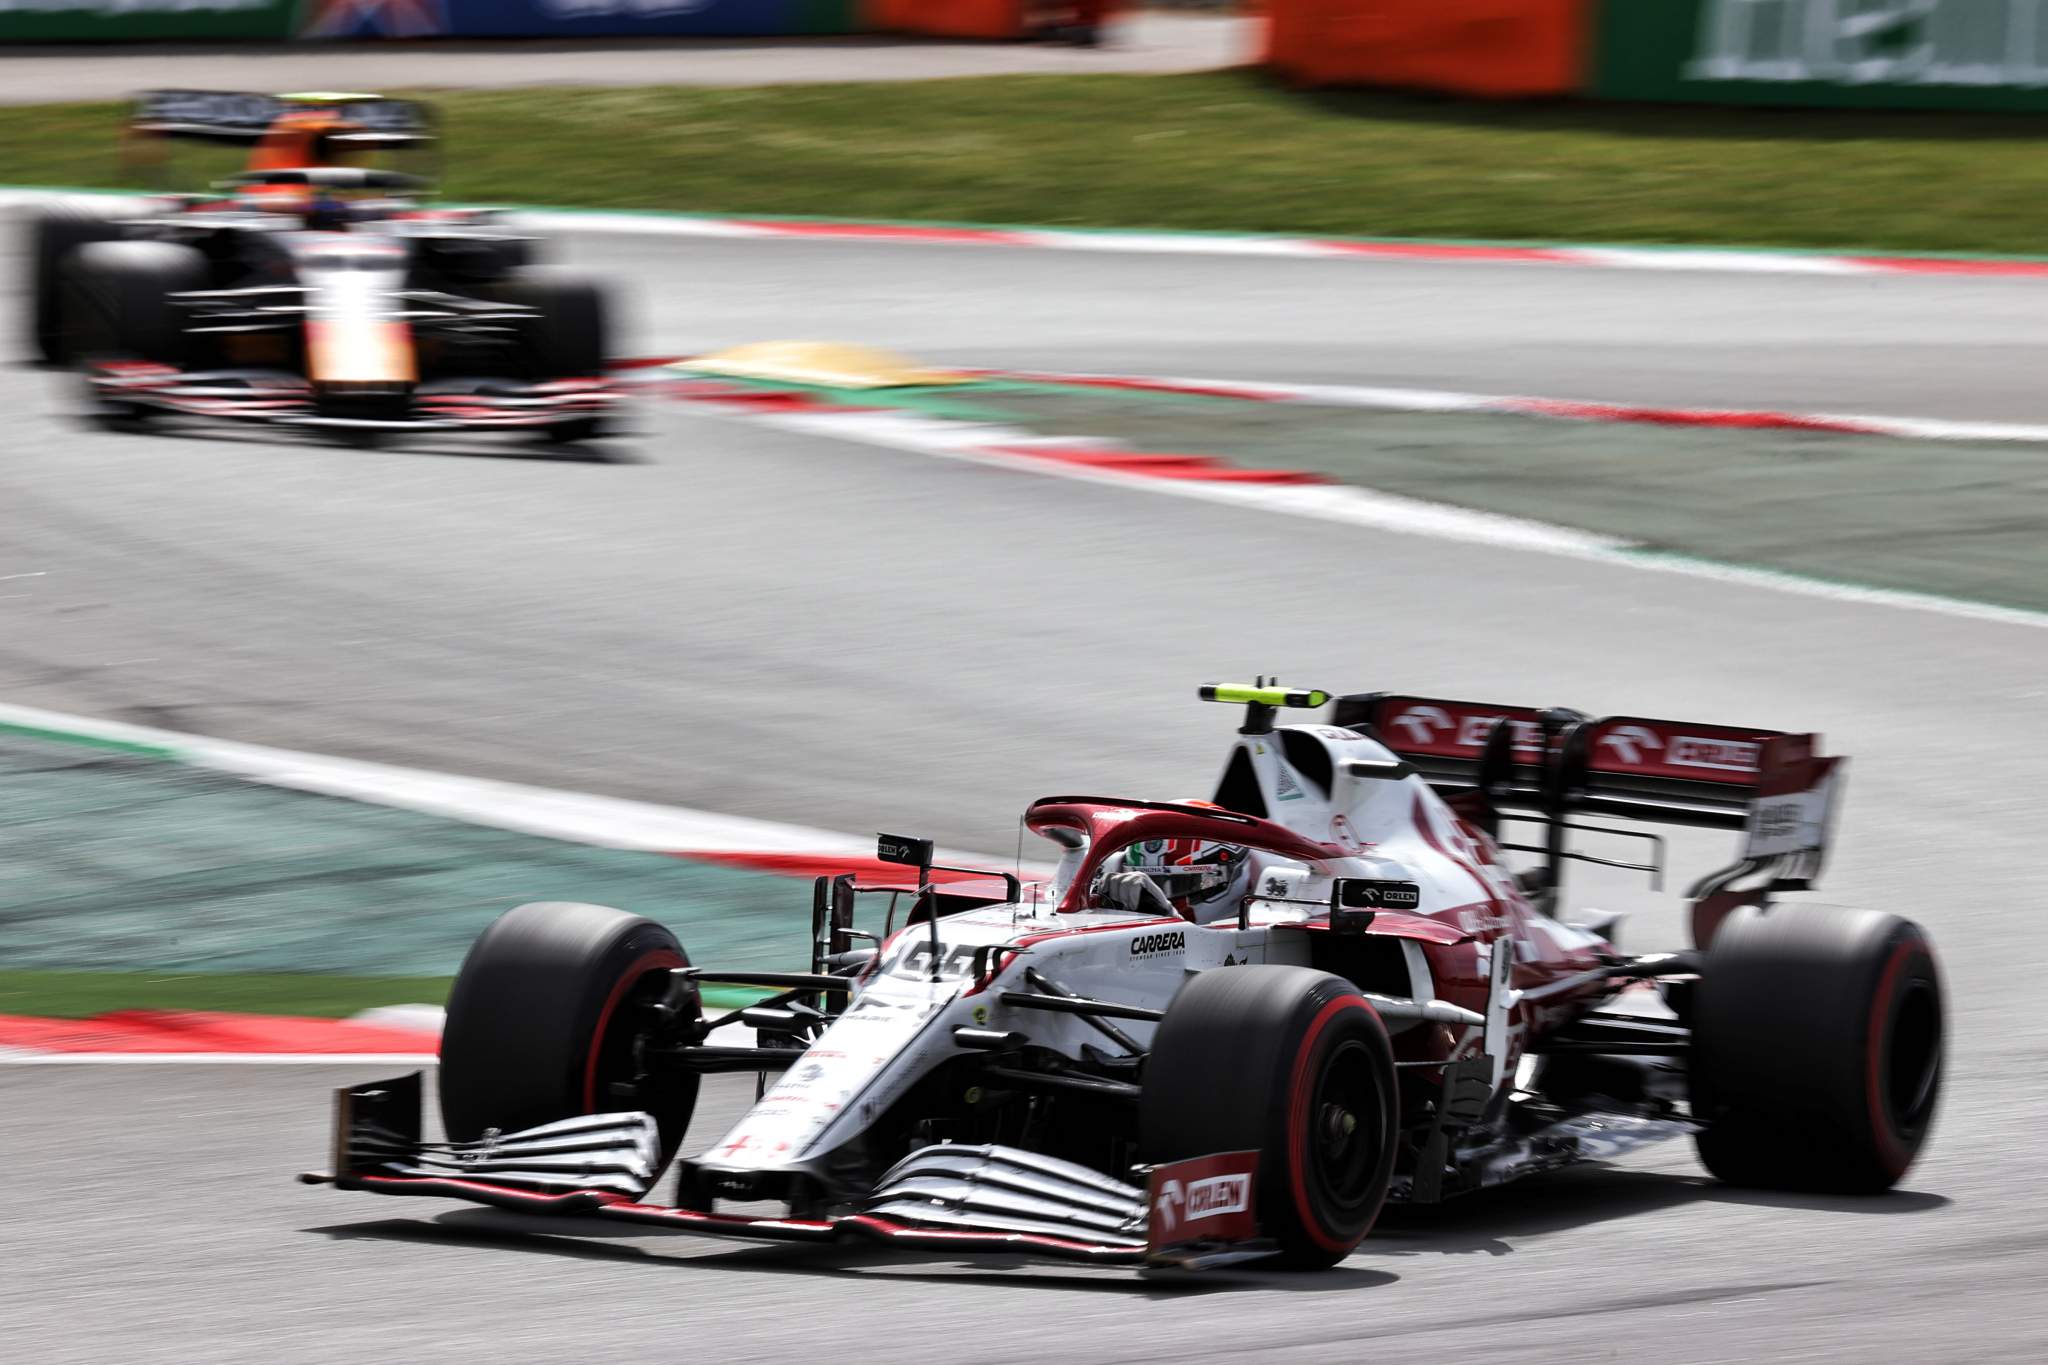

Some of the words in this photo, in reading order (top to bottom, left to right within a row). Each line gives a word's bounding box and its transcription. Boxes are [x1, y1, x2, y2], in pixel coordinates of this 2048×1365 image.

[1384, 892, 1417, 902] ORLEN
[1131, 931, 1185, 955] CARRERA
[1188, 1177, 1246, 1215] ORLEN
